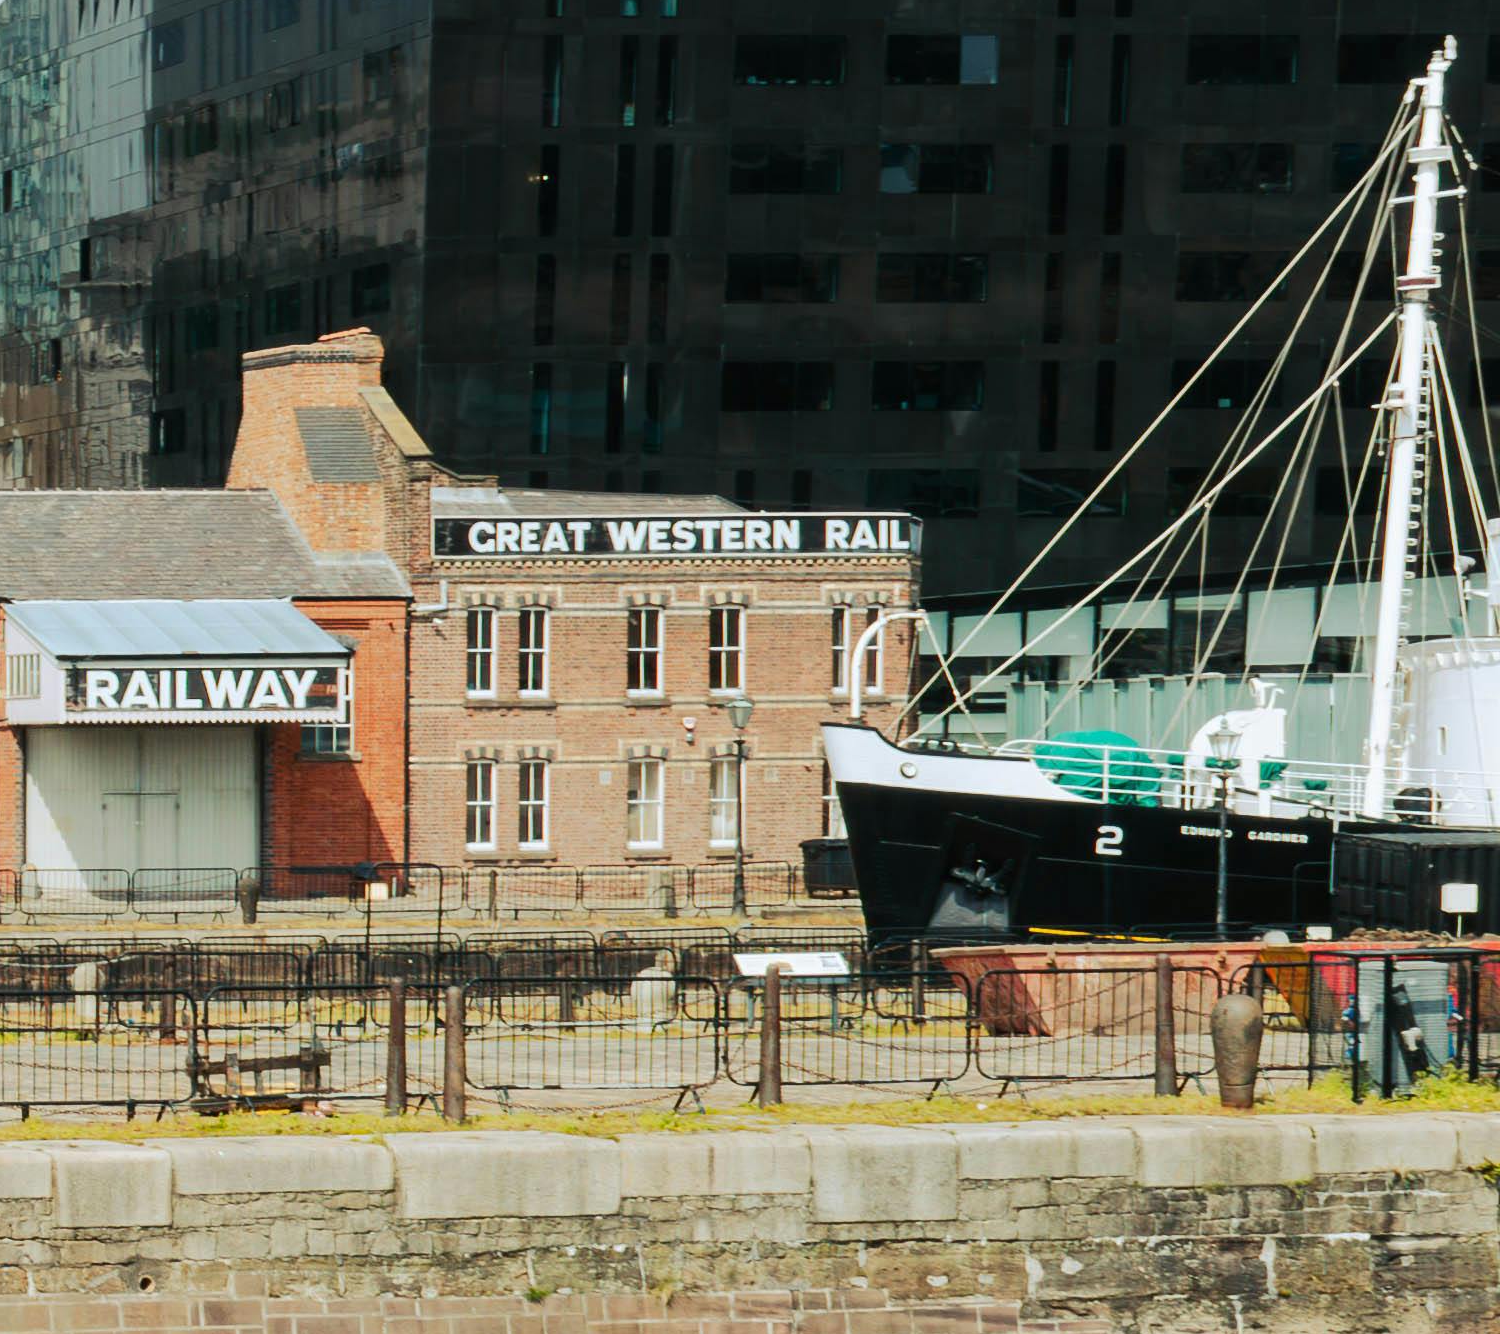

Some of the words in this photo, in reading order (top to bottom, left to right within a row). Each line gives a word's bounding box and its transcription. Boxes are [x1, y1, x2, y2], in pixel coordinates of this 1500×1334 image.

[468, 520, 591, 553] GREAT
[606, 520, 800, 552] WESTERN
[825, 519, 910, 550] RAIL
[86, 669, 318, 709] RAILWAY
[1095, 825, 1124, 856] 2
[1247, 830, 1308, 844] GARDNER
